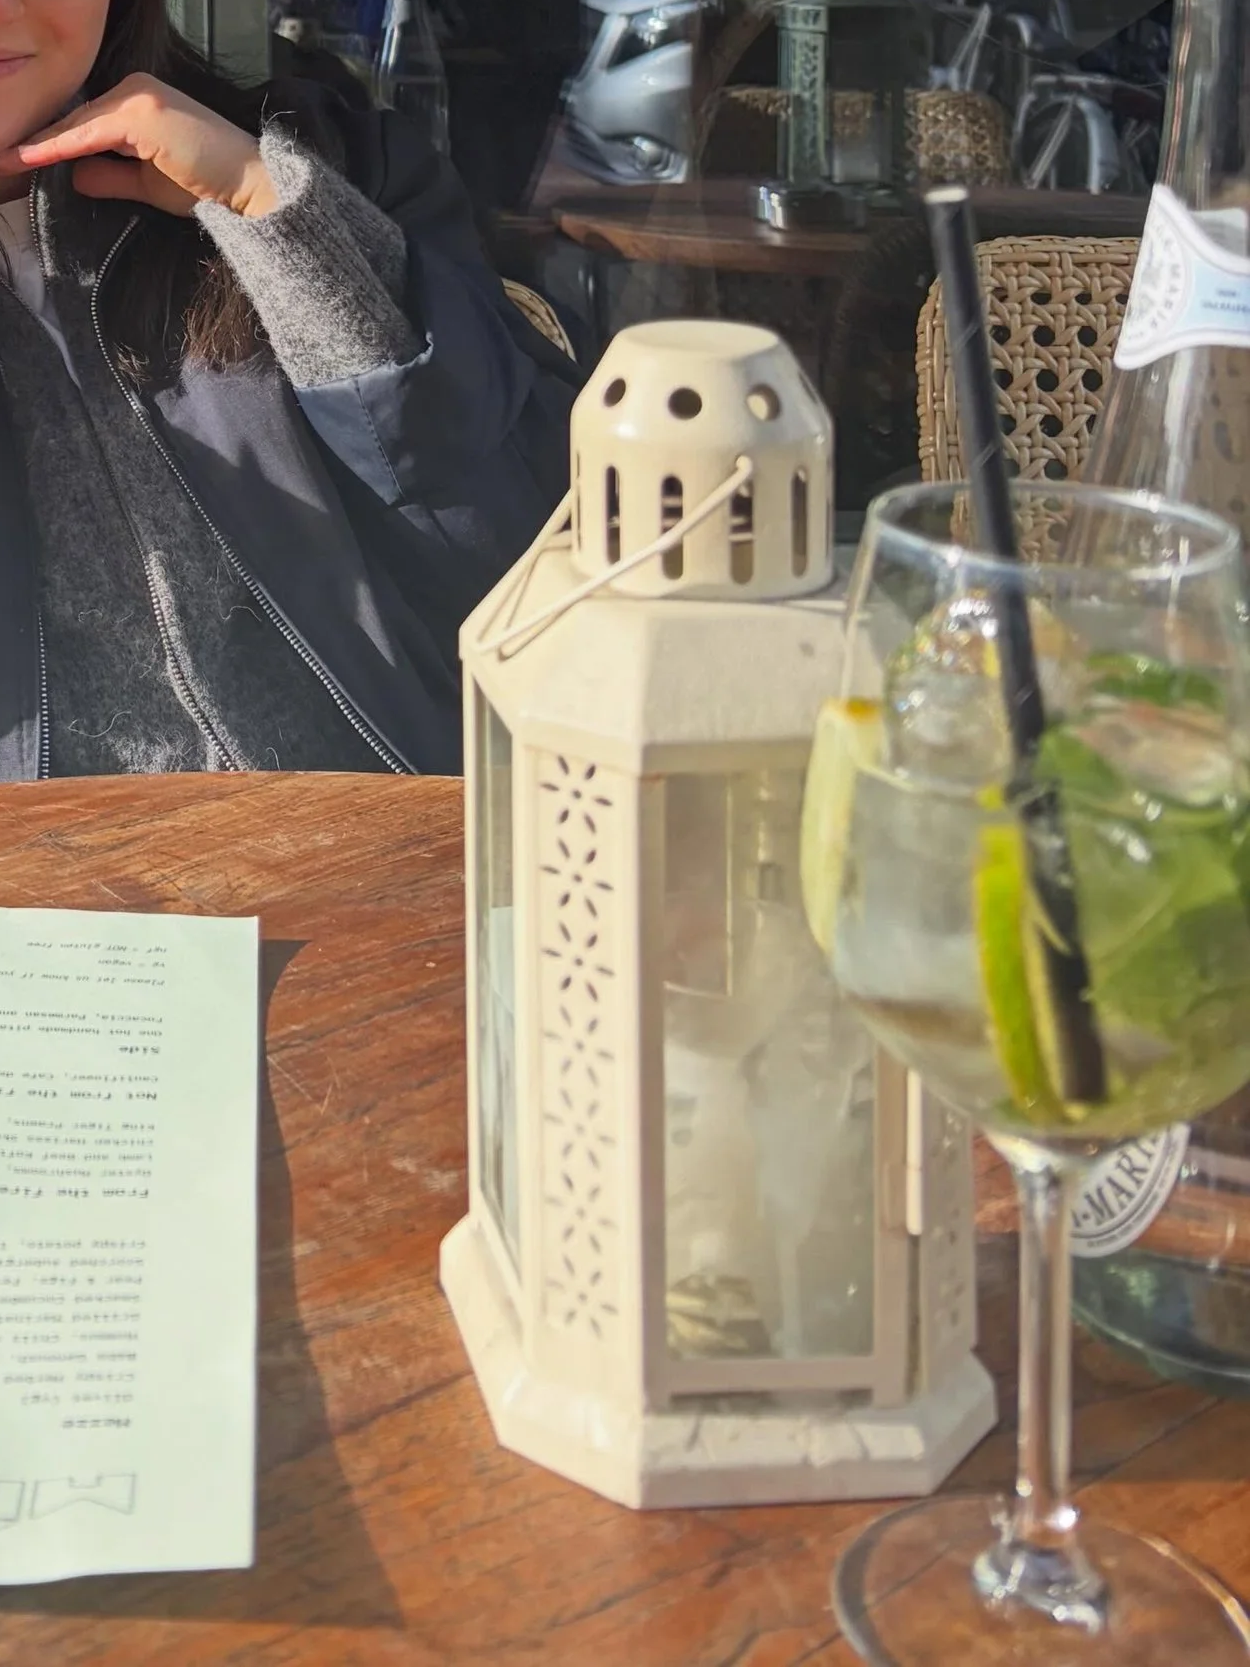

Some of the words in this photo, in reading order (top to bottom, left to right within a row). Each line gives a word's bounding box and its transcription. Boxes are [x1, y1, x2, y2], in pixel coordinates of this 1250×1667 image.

[117, 1046, 159, 1055] Side
[26, 1090, 57, 1099] the
[69, 1091, 111, 1101] from
[125, 1092, 157, 1101] Not
[55, 1188, 88, 1199] the
[101, 1188, 148, 1199] From
